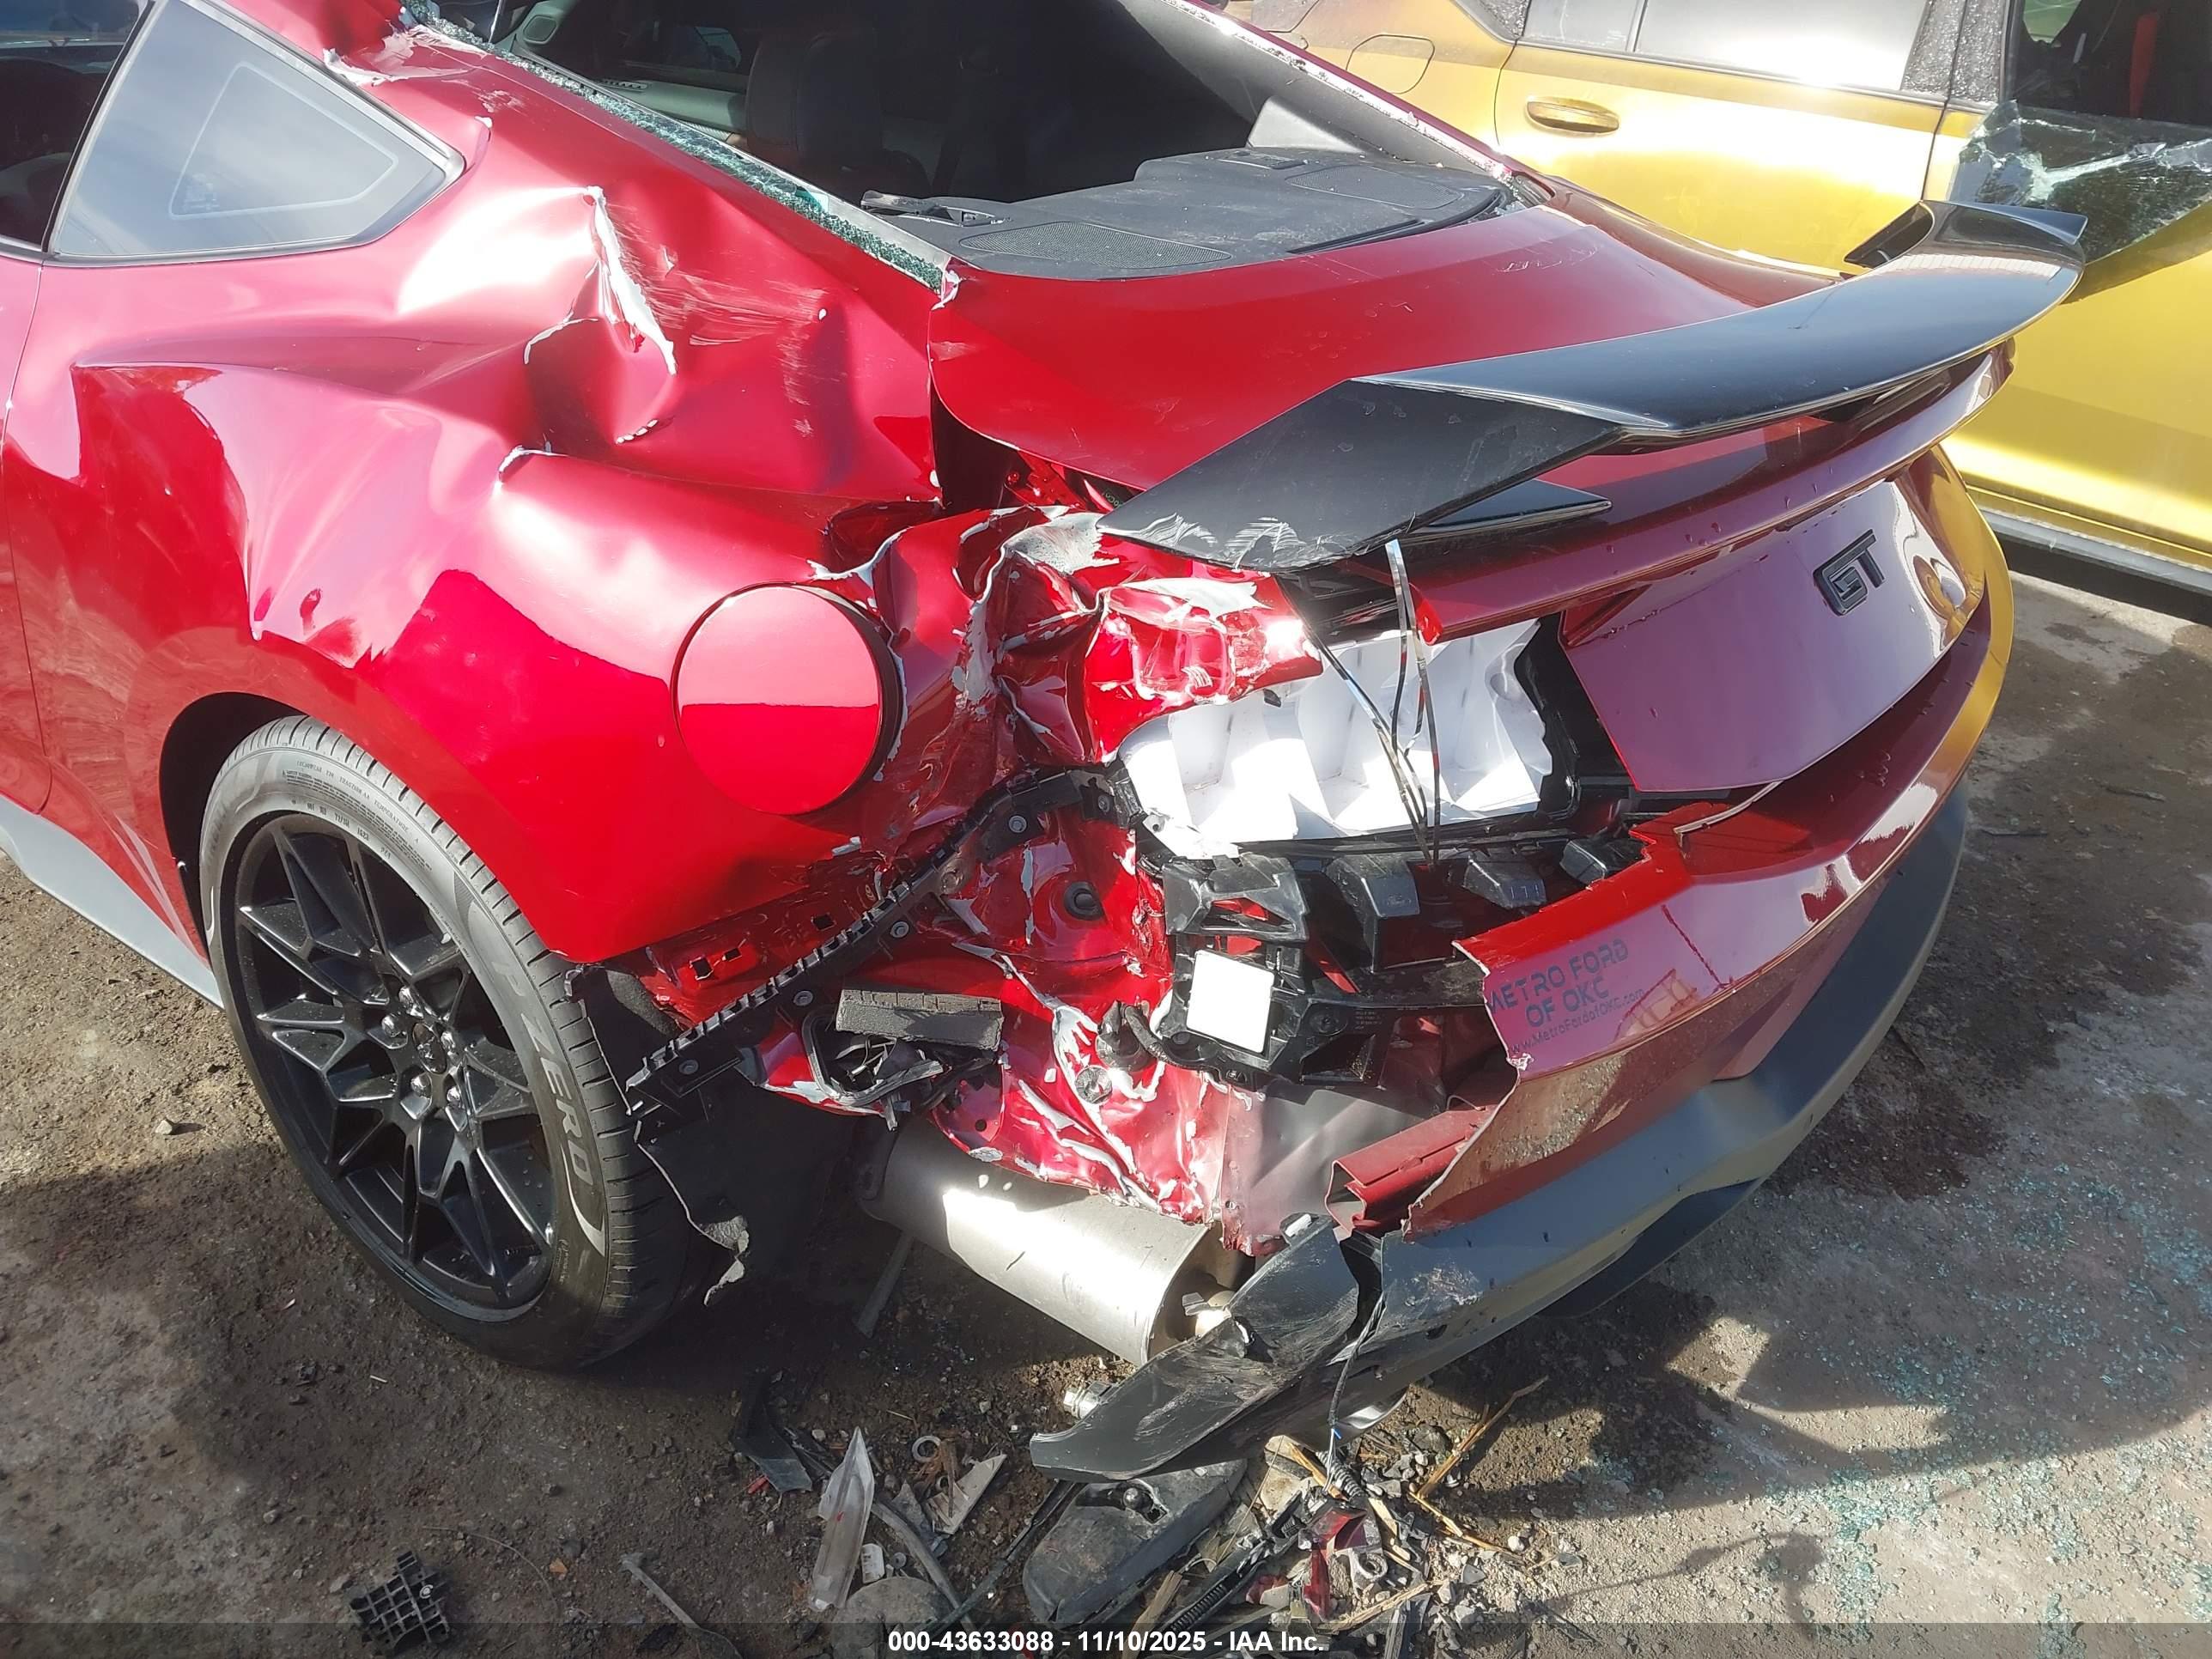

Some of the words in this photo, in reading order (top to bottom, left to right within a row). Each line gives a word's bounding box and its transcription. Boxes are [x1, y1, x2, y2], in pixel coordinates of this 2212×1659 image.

[1813, 529, 1885, 617] GT
[1569, 939, 1628, 980] FORD
[1526, 996, 1555, 1027] OF
[1563, 975, 1608, 1012] OKC
[491, 961, 526, 997] P
[520, 1013, 593, 1186] ZERO
